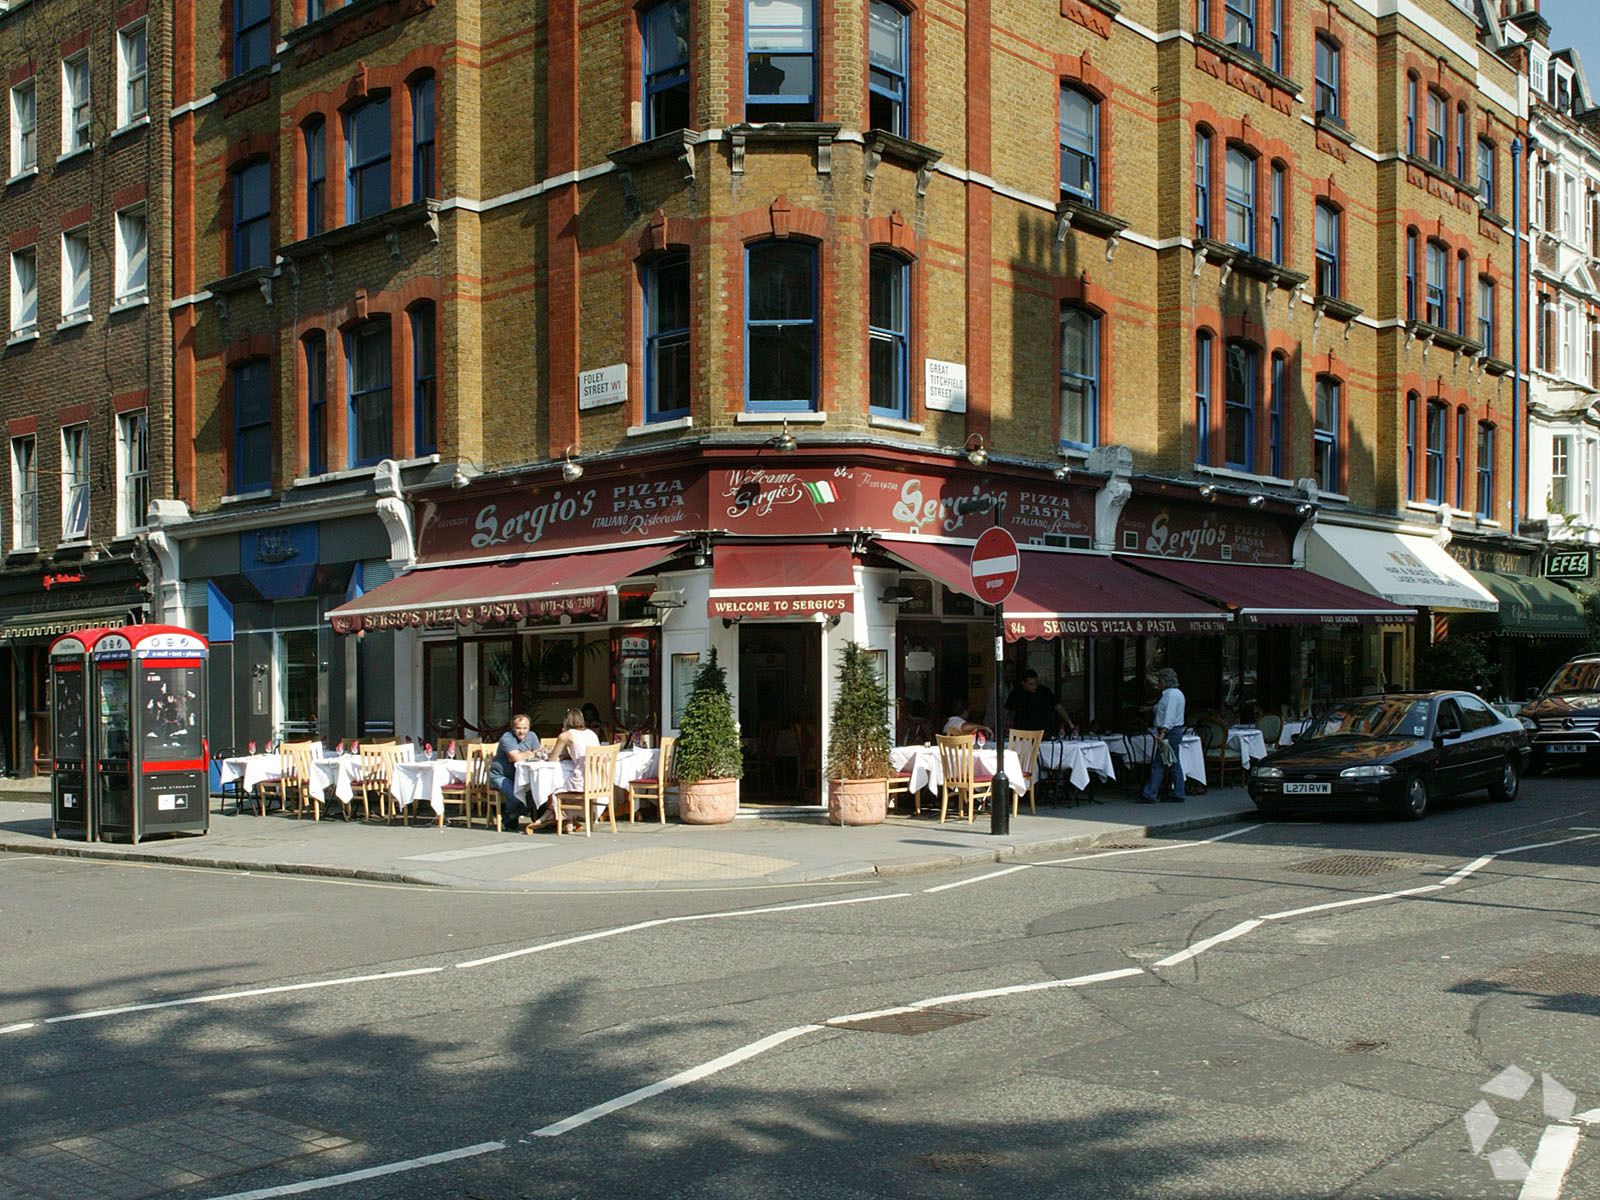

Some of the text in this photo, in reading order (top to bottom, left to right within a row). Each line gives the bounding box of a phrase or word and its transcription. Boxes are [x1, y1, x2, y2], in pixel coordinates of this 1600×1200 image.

[929, 363, 949, 375] GREAT
[583, 372, 605, 385] FOLEY
[929, 375, 964, 390] TITCHFIELD
[583, 380, 621, 397] STREET W1
[930, 386, 952, 399] STREET
[725, 465, 799, 487] Welcome
[613, 479, 685, 498] PIZZA
[613, 494, 685, 512] PASTA
[727, 483, 803, 518] Sergio's
[893, 479, 1008, 532] Sergio's
[1020, 492, 1070, 508] PIZZA
[471, 488, 597, 549] Sergio's
[1020, 504, 1071, 520] PASTA
[592, 514, 629, 529] ITALIANO
[1011, 516, 1049, 529] ITALIANO
[1146, 514, 1228, 559] Sergio's
[1234, 525, 1265, 537] PIZZA
[1234, 536, 1265, 549] PASTA
[1550, 556, 1587, 573] EFES
[715, 599, 846, 612] WELCOME TO SERGIO'S
[364, 611, 420, 628] SERGIO'S
[425, 609, 461, 623] PIZZA
[465, 607, 474, 619] &
[480, 603, 520, 618] PASTA
[1011, 622, 1026, 634] 84a
[1043, 620, 1099, 634] SERGIO'S
[1102, 620, 1135, 633] PIZZA
[1136, 620, 1143, 632] &
[1147, 620, 1177, 633] PASTA
